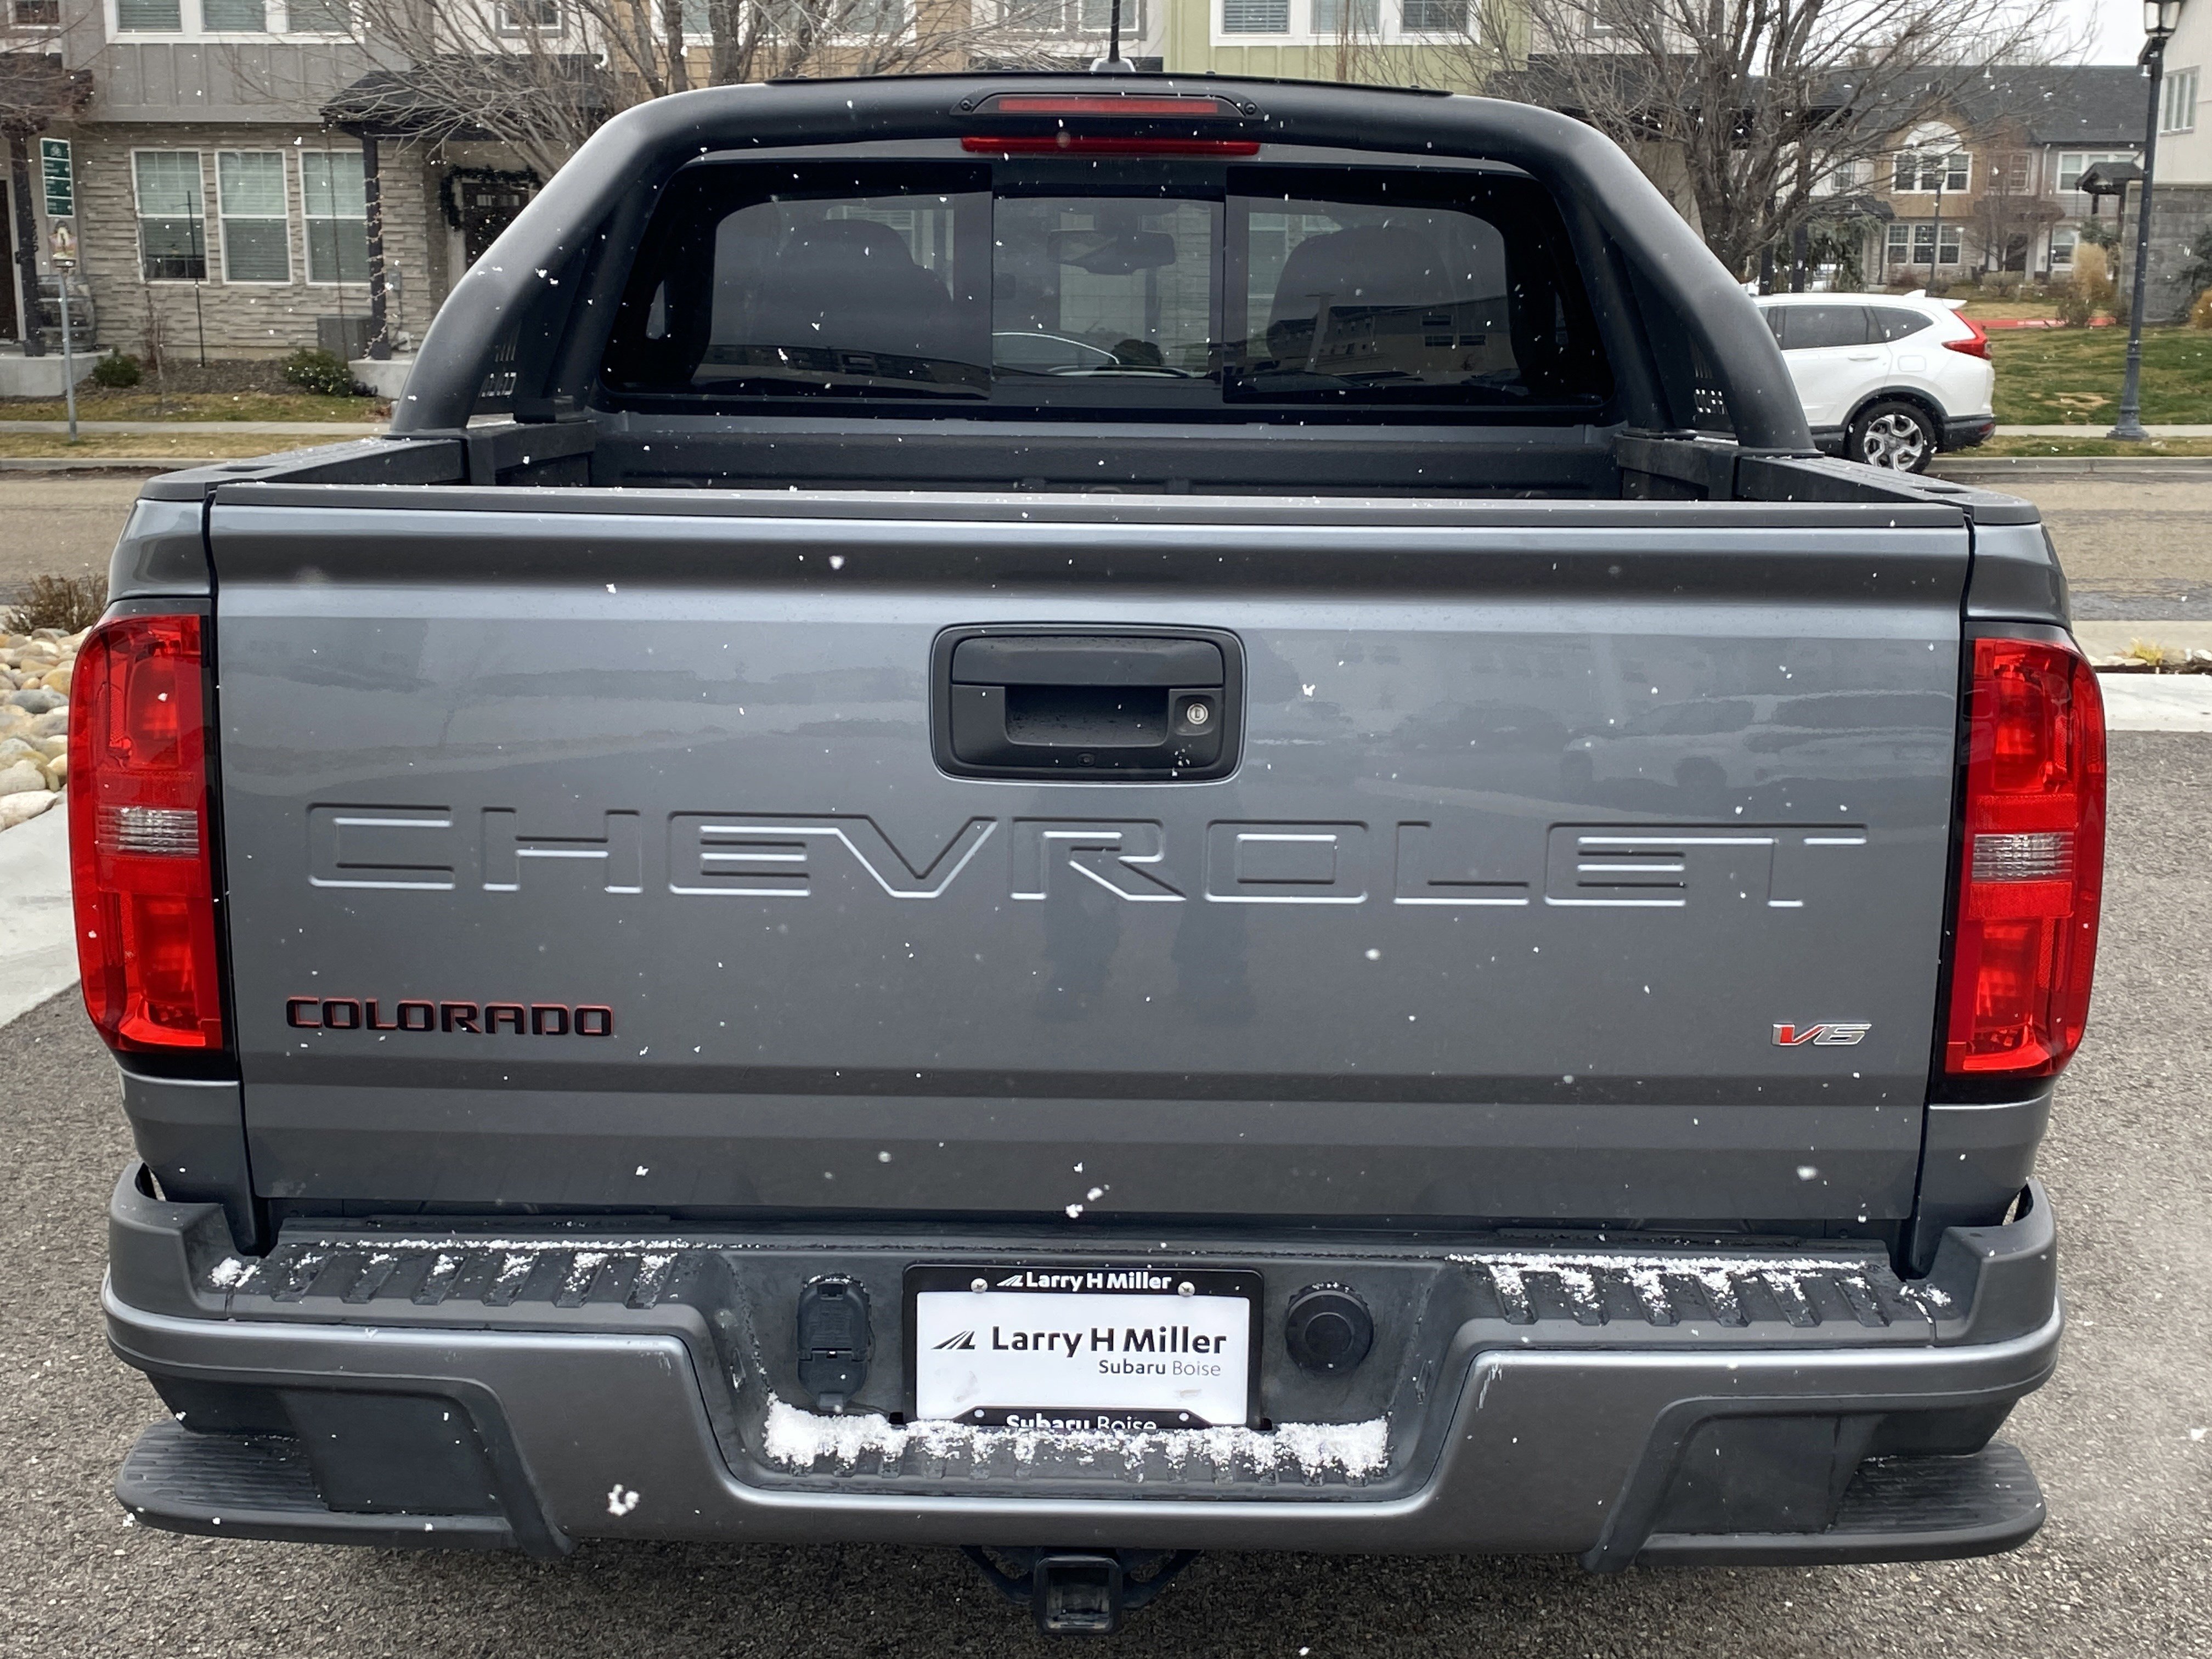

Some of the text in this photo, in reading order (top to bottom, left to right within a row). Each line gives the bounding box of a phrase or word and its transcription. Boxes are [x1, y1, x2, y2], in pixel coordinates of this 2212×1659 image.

[306, 803, 1866, 909] CHEVROLET
[286, 996, 613, 1036] COLORADO
[1771, 1023, 1872, 1046] V6
[1026, 1271, 1172, 1291] Larry H Miller
[992, 1325, 1227, 1358] Larry H Miller
[1098, 1358, 1221, 1377] Subaru Boise
[1006, 1413, 1091, 1430] Subaru
